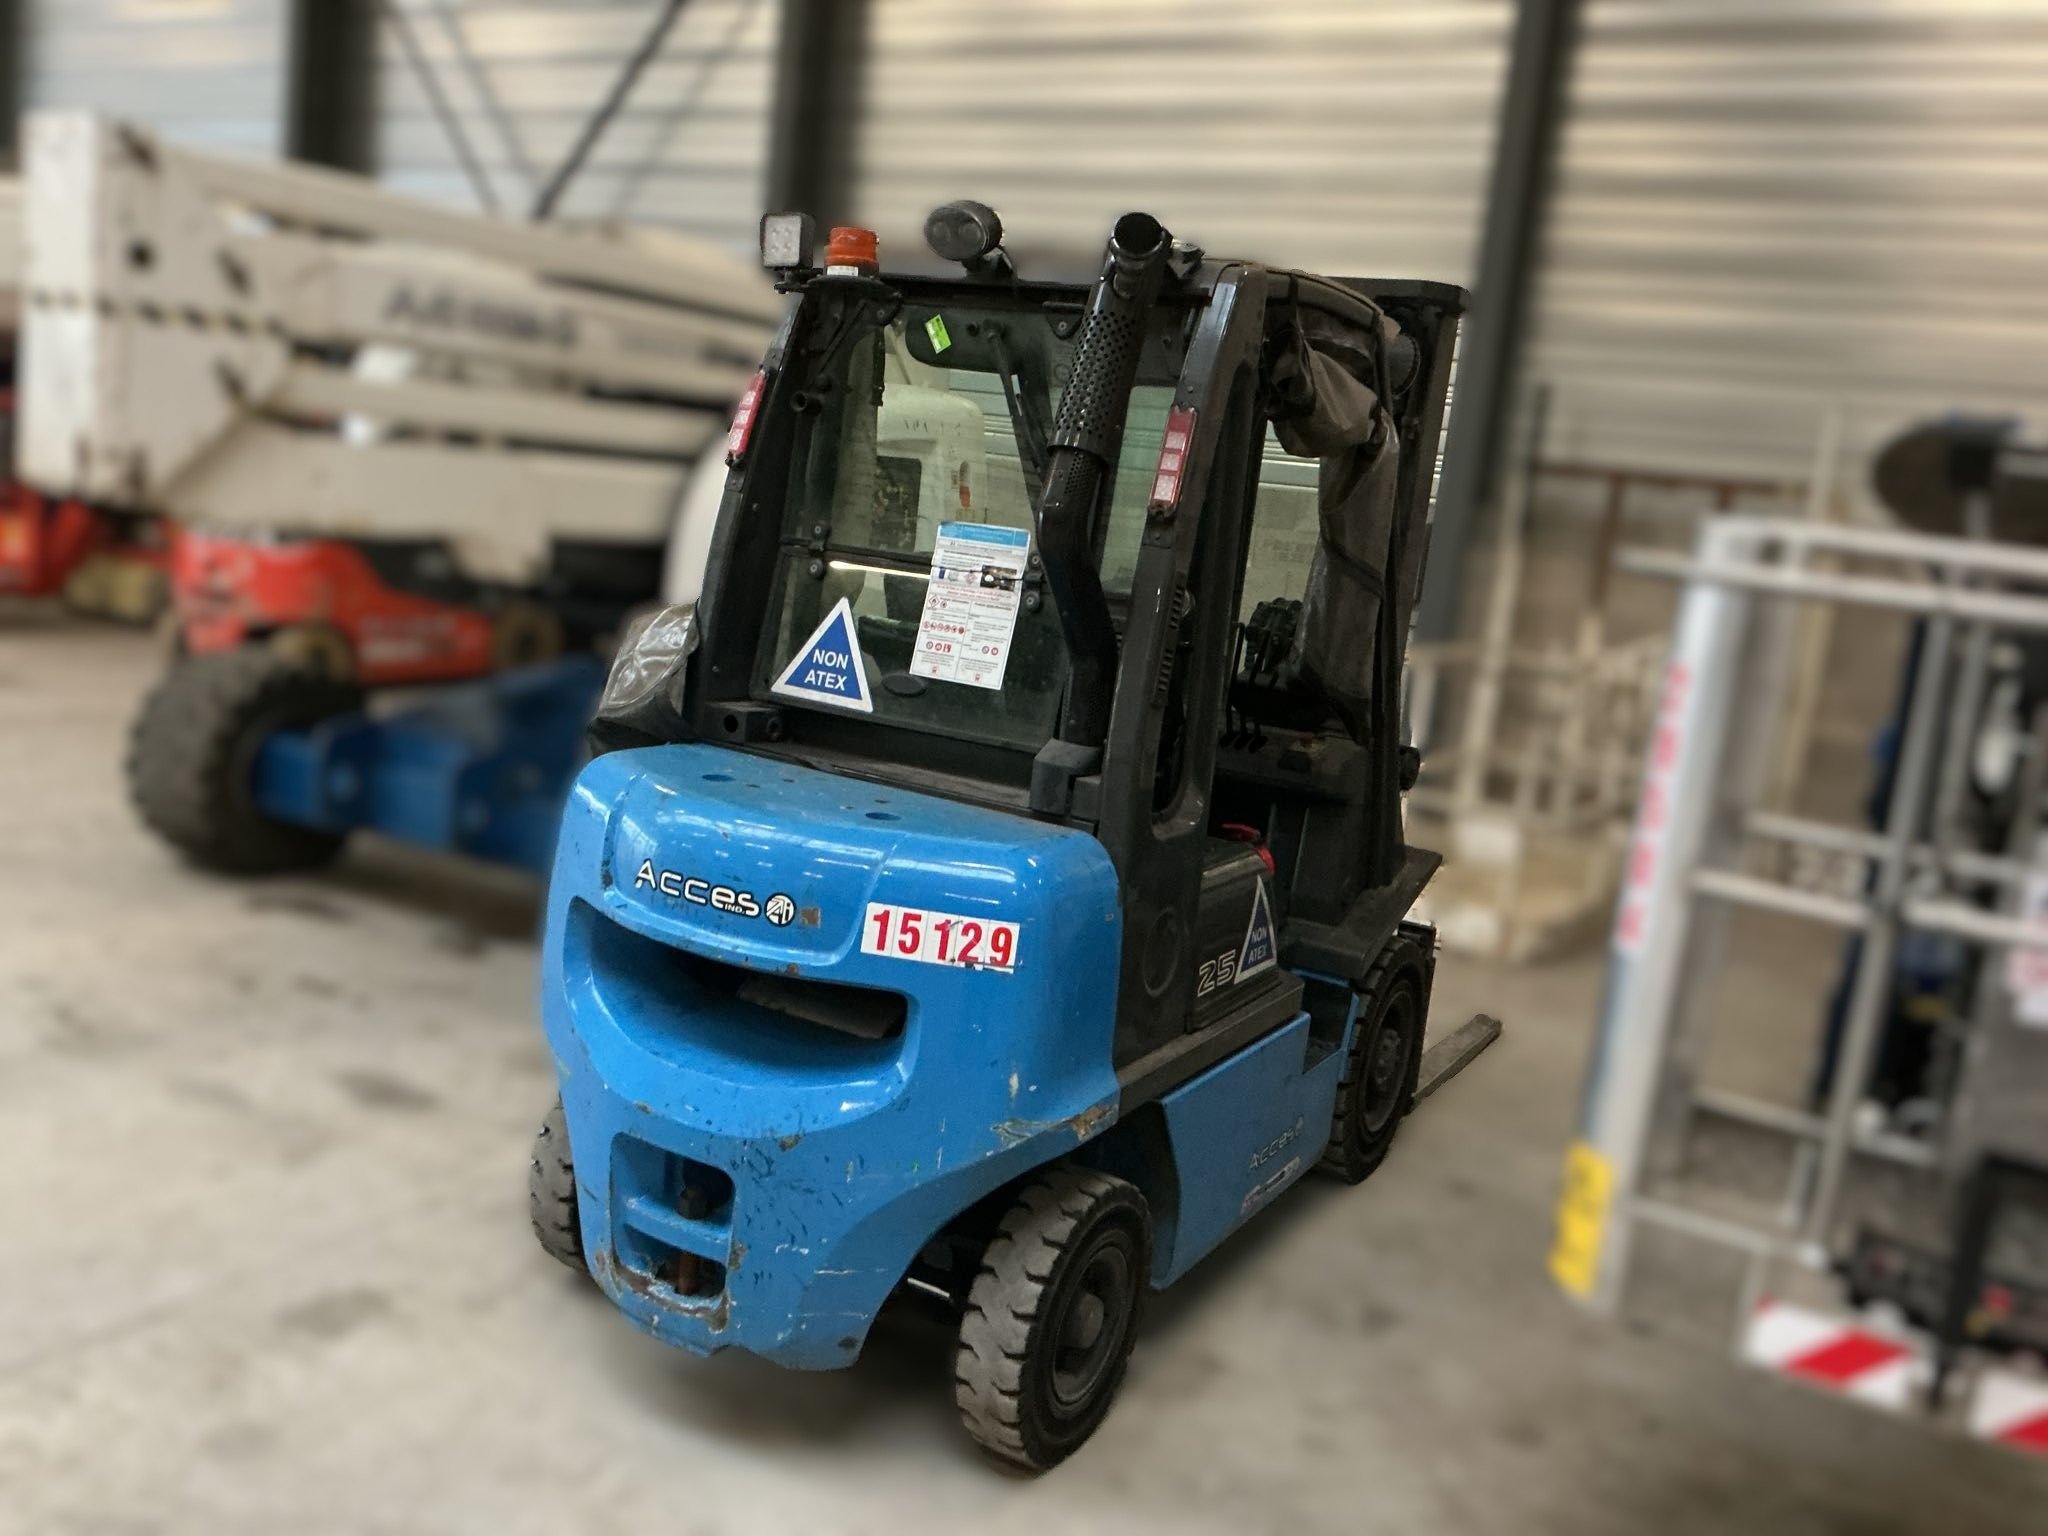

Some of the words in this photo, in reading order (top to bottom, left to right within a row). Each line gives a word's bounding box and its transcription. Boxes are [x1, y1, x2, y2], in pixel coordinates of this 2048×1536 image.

[812, 648, 849, 670] NON
[804, 668, 848, 691] ATEX
[633, 858, 760, 917] Acces
[1251, 926, 1268, 944] NON
[1197, 949, 1237, 997] 25
